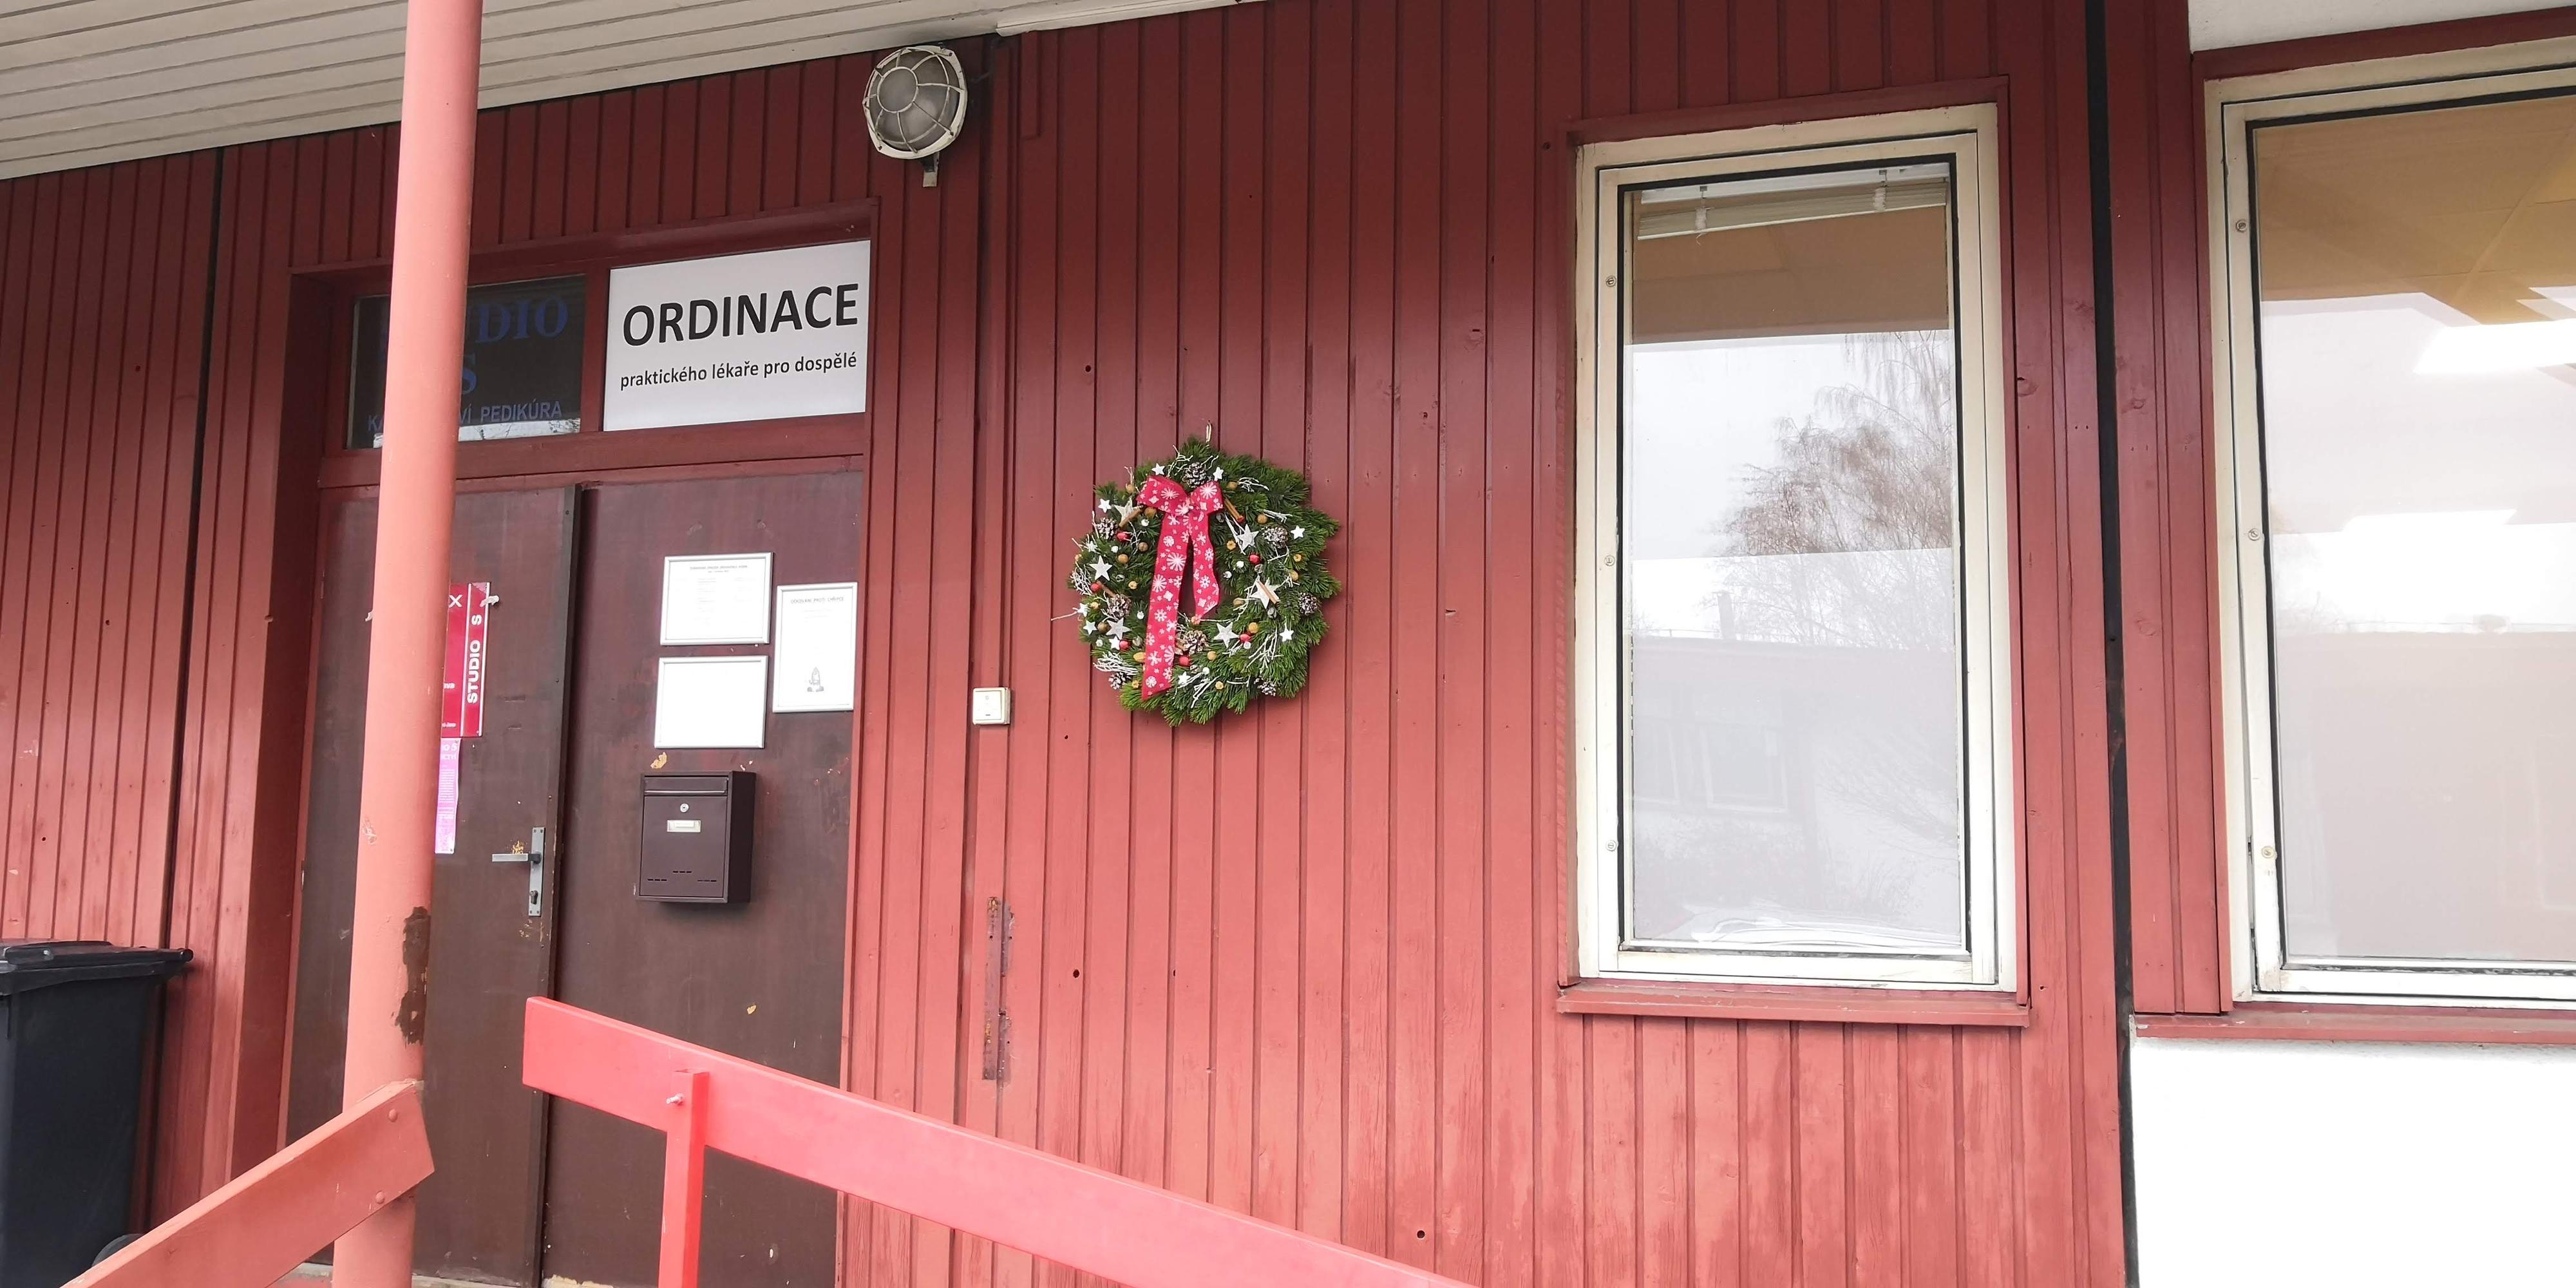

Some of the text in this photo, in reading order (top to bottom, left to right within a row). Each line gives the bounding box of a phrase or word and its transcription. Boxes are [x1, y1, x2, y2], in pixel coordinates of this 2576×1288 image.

[474, 296, 568, 343] DIO
[623, 283, 858, 346] ORDINACE
[621, 352, 857, 391] praktického lékaře pro dospělé
[480, 397, 562, 423] PEDIKÚRA
[467, 614, 482, 704] STUDIO S
